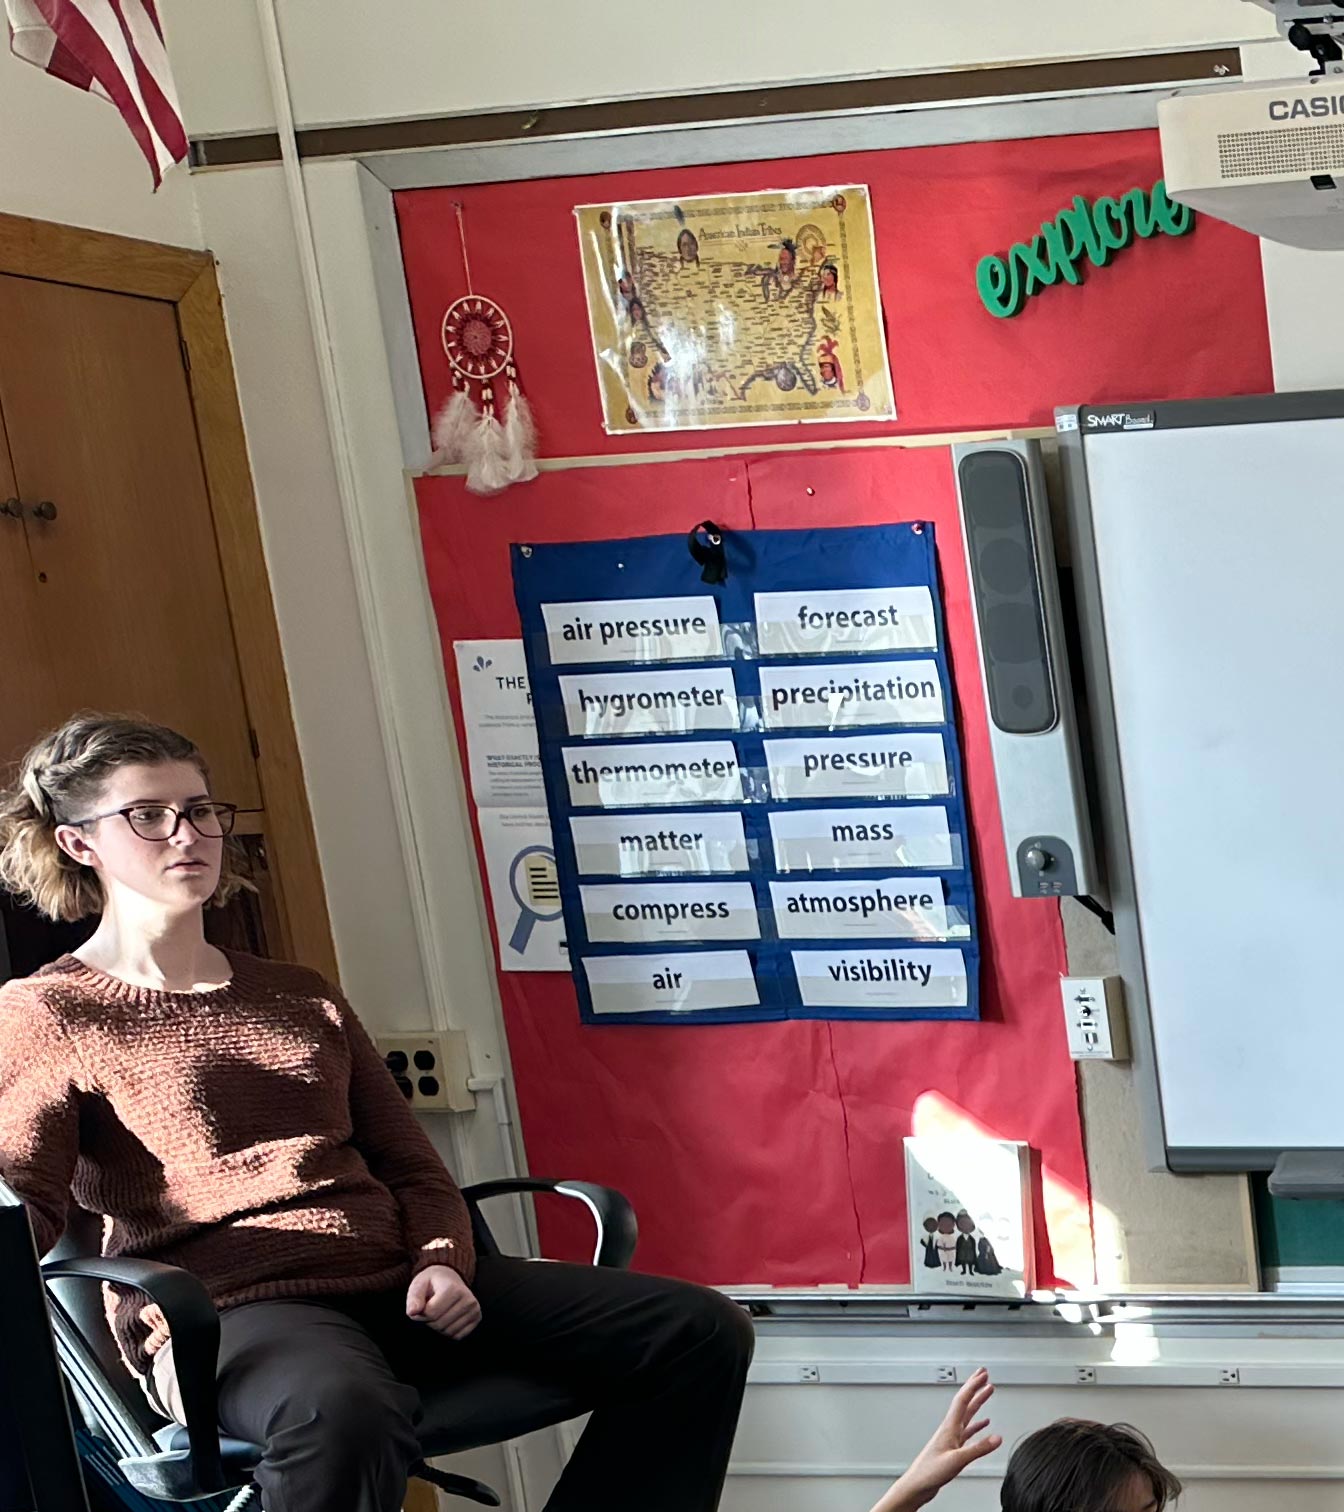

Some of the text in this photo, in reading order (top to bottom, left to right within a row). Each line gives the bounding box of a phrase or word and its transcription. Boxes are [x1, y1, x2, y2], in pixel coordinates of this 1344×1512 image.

[699, 226, 736, 241] American
[976, 179, 1194, 318] explore
[1088, 413, 1125, 427] SMART
[563, 612, 706, 645] air pressure
[798, 605, 898, 632] forecast
[496, 677, 526, 690] THE
[771, 677, 936, 710] precipitation
[580, 685, 725, 718] hygrometer
[571, 757, 736, 787] thermometer
[803, 748, 913, 778] pressure
[620, 830, 703, 853] matter
[831, 820, 894, 842] mass
[612, 896, 730, 925] compress
[787, 888, 934, 918] atmosphere
[653, 968, 683, 990] air
[828, 959, 932, 987] visibility
